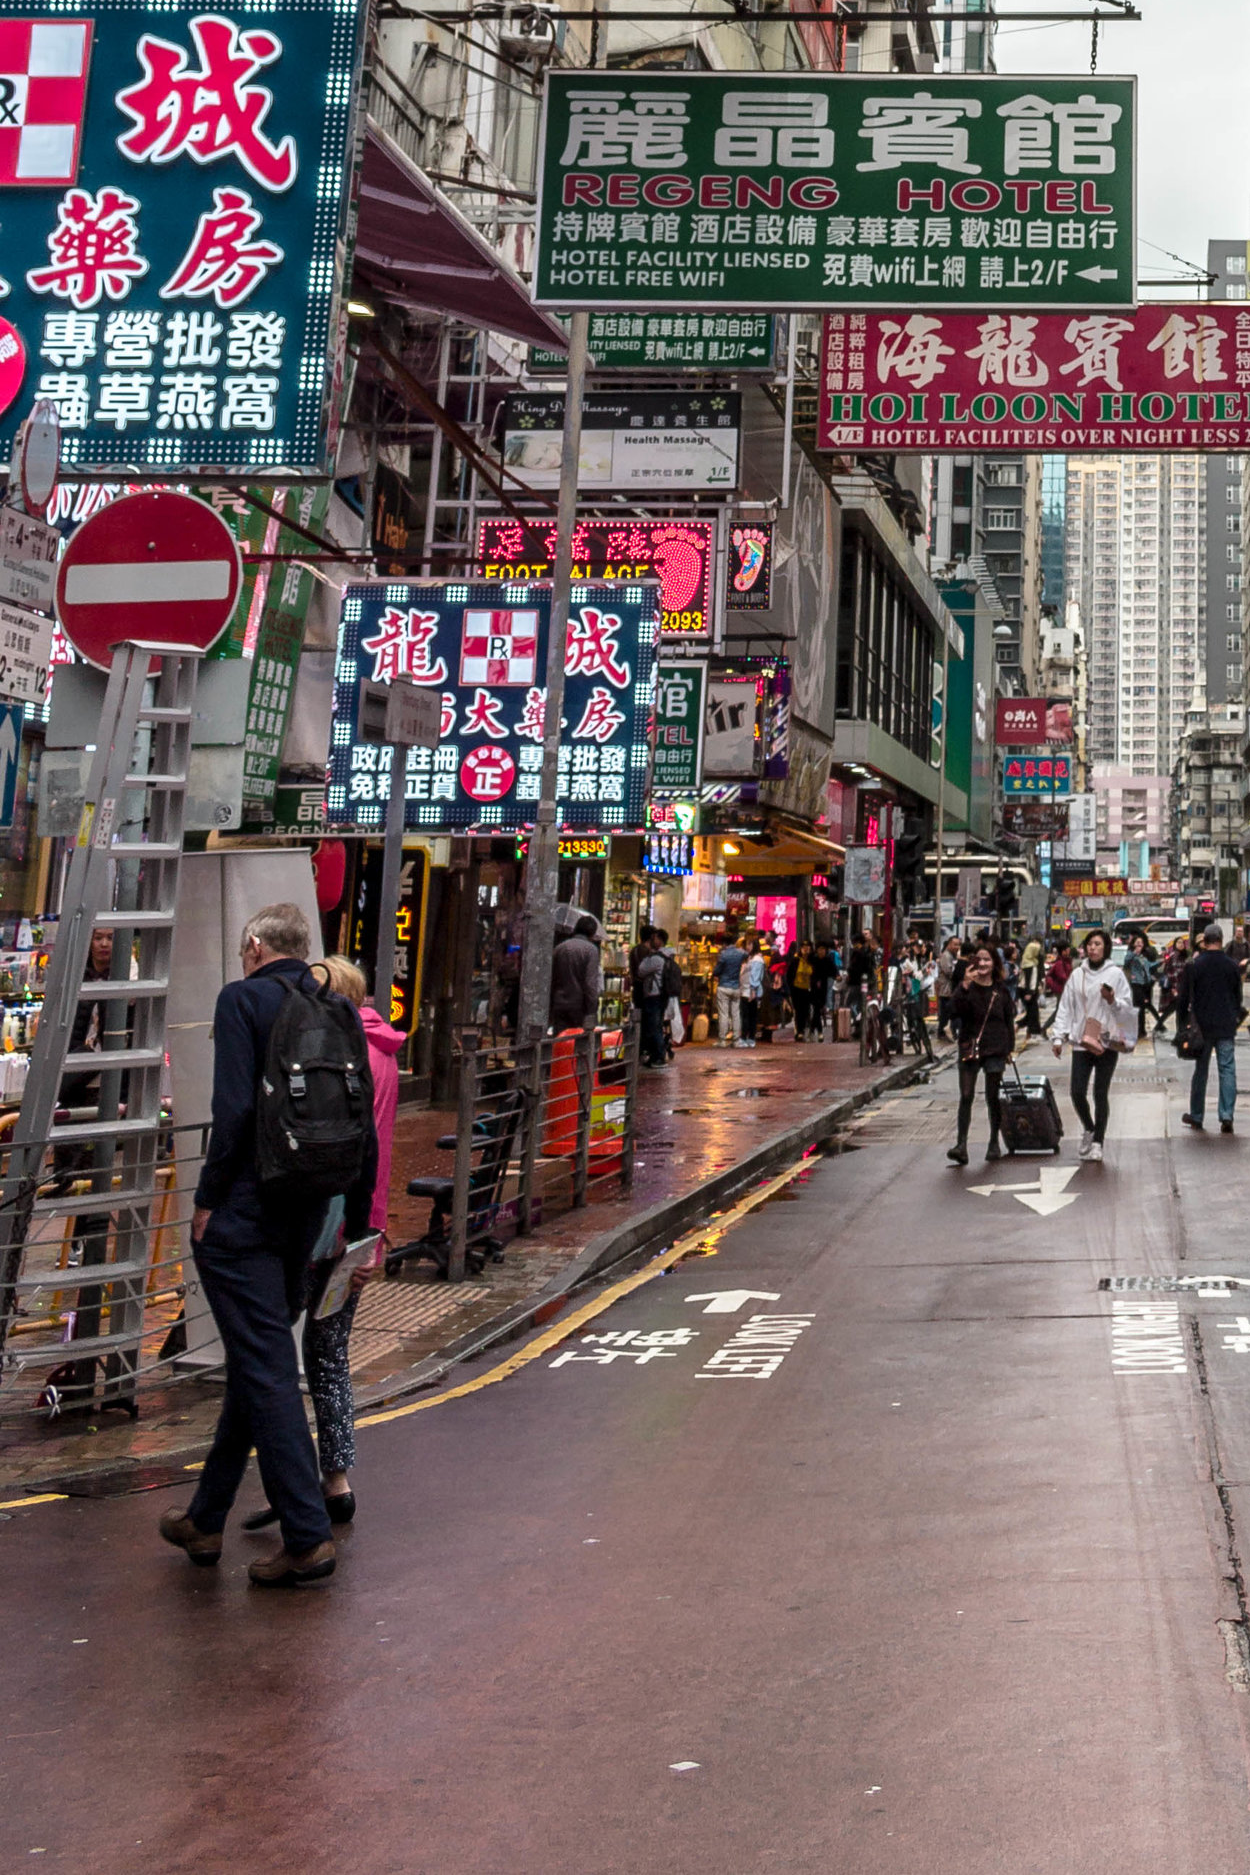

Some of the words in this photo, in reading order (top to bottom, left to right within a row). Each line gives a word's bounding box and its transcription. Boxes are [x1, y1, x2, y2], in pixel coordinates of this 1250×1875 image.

[115, 14, 297, 193] 城
[559, 90, 1122, 176] 麗晶賓館
[562, 172, 840, 211] REGENG
[896, 178, 1114, 215] HOTEL
[0, 187, 284, 309] 藥房
[552, 211, 681, 245] 持牌賓館
[690, 214, 817, 247] 酒店設備
[826, 215, 952, 248] 豪華套房
[960, 217, 1119, 250] 歡迎自由行
[551, 249, 621, 267] HOTEL
[626, 250, 719, 268] FACILITY
[724, 252, 811, 269] LIENSED
[823, 253, 967, 289] 免費wifi上網
[980, 256, 1069, 289] 請上2/F
[550, 269, 620, 286] HOTEL
[625, 271, 673, 287] FREE
[679, 272, 725, 288] WIFI
[39, 311, 286, 370] 專營批發
[592, 318, 644, 337] 酒店設備
[647, 319, 699, 337] 豪華套房
[702, 319, 766, 338] 歡迎自由行
[876, 313, 1229, 392] 海龍賓館
[34, 371, 282, 431] 蟲草燕窩
[826, 392, 929, 424] HOI
[939, 392, 1086, 424] LOON
[624, 435, 660, 445] Health
[663, 436, 711, 447] Massage
[871, 429, 940, 445] HOTEL
[944, 429, 1057, 445] FACILITEIS
[1061, 429, 1116, 444] OVER
[1121, 429, 1187, 444] NIGHT
[1191, 429, 1240, 444] LESS
[711, 467, 730, 477] 1/F
[362, 606, 447, 686] 龍
[471, 765, 502, 796] 正
[722, 1313, 817, 1348] LOOK
[1111, 1300, 1180, 1336] RIGHT
[694, 1347, 792, 1379] LEFT
[1111, 1336, 1188, 1375] LOOK
